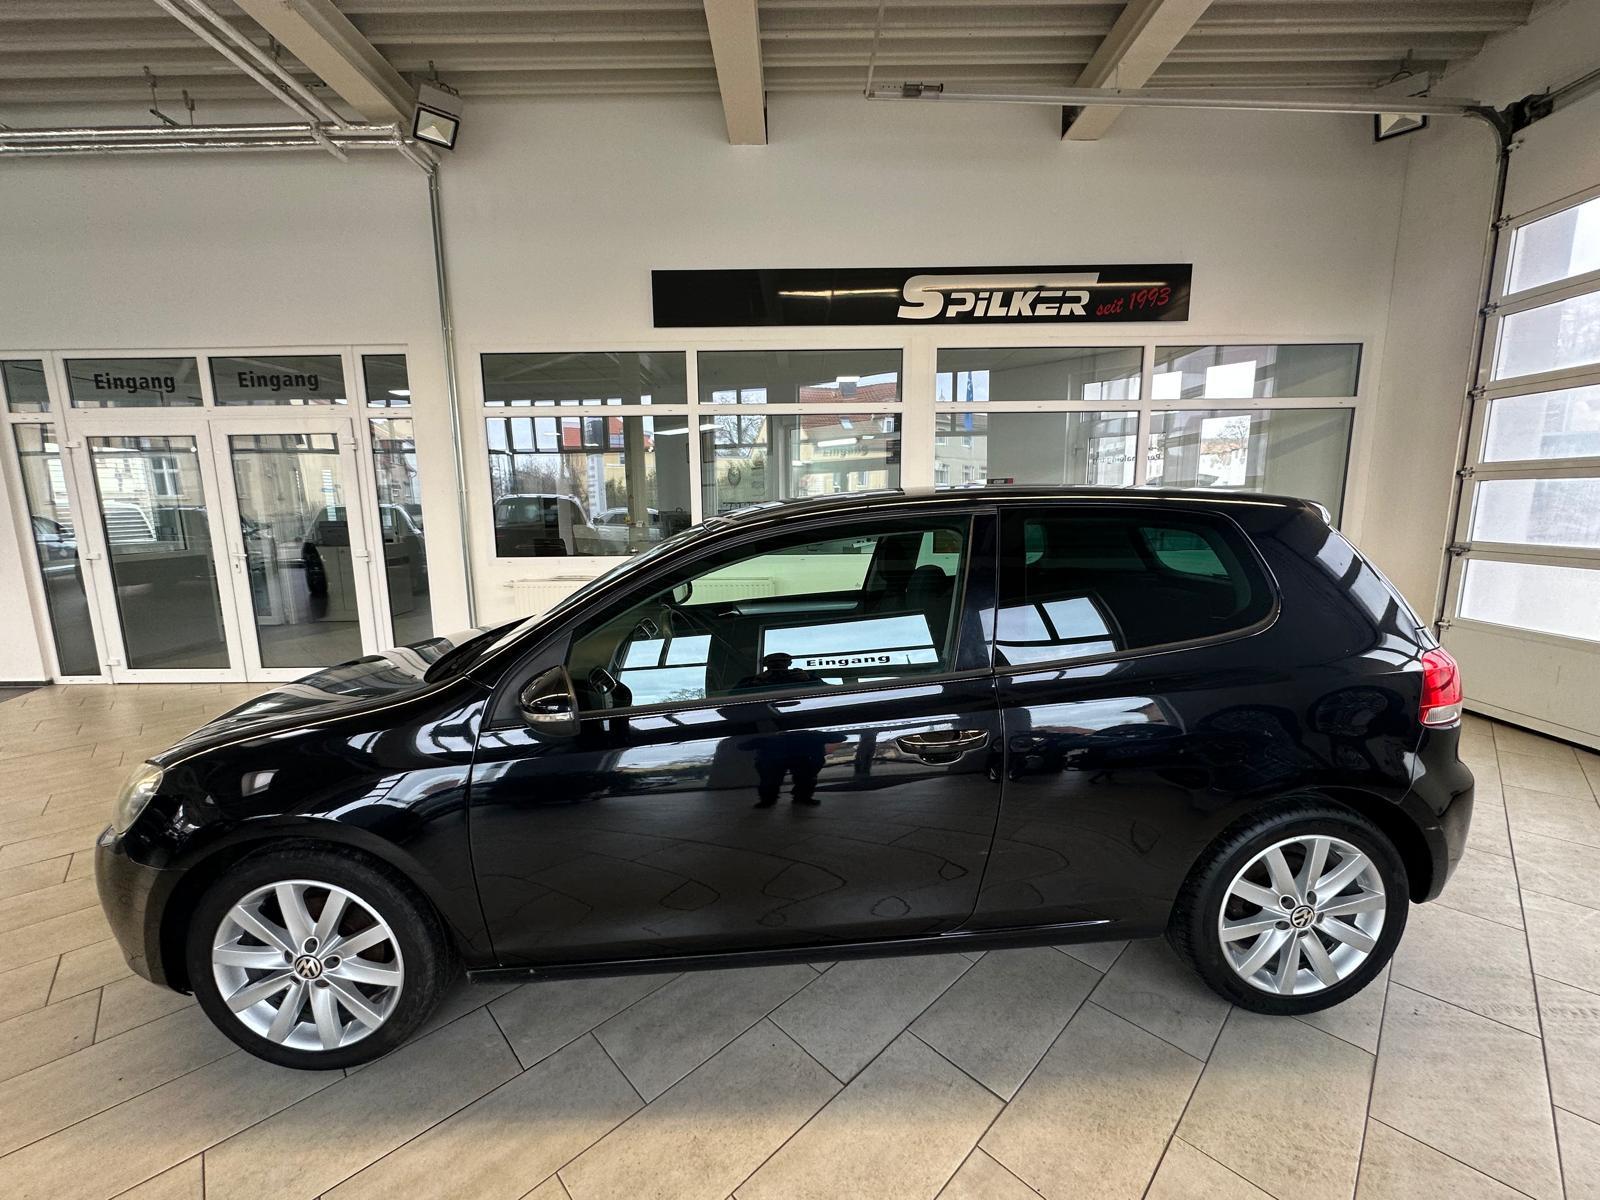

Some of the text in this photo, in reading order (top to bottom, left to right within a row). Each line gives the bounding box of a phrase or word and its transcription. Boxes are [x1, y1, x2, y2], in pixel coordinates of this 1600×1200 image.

[1096, 299, 1124, 316] seit
[1127, 287, 1172, 311] 1993
[94, 373, 175, 393] Eingang
[238, 371, 319, 391] Eingang
[806, 655, 890, 667] Eingang
